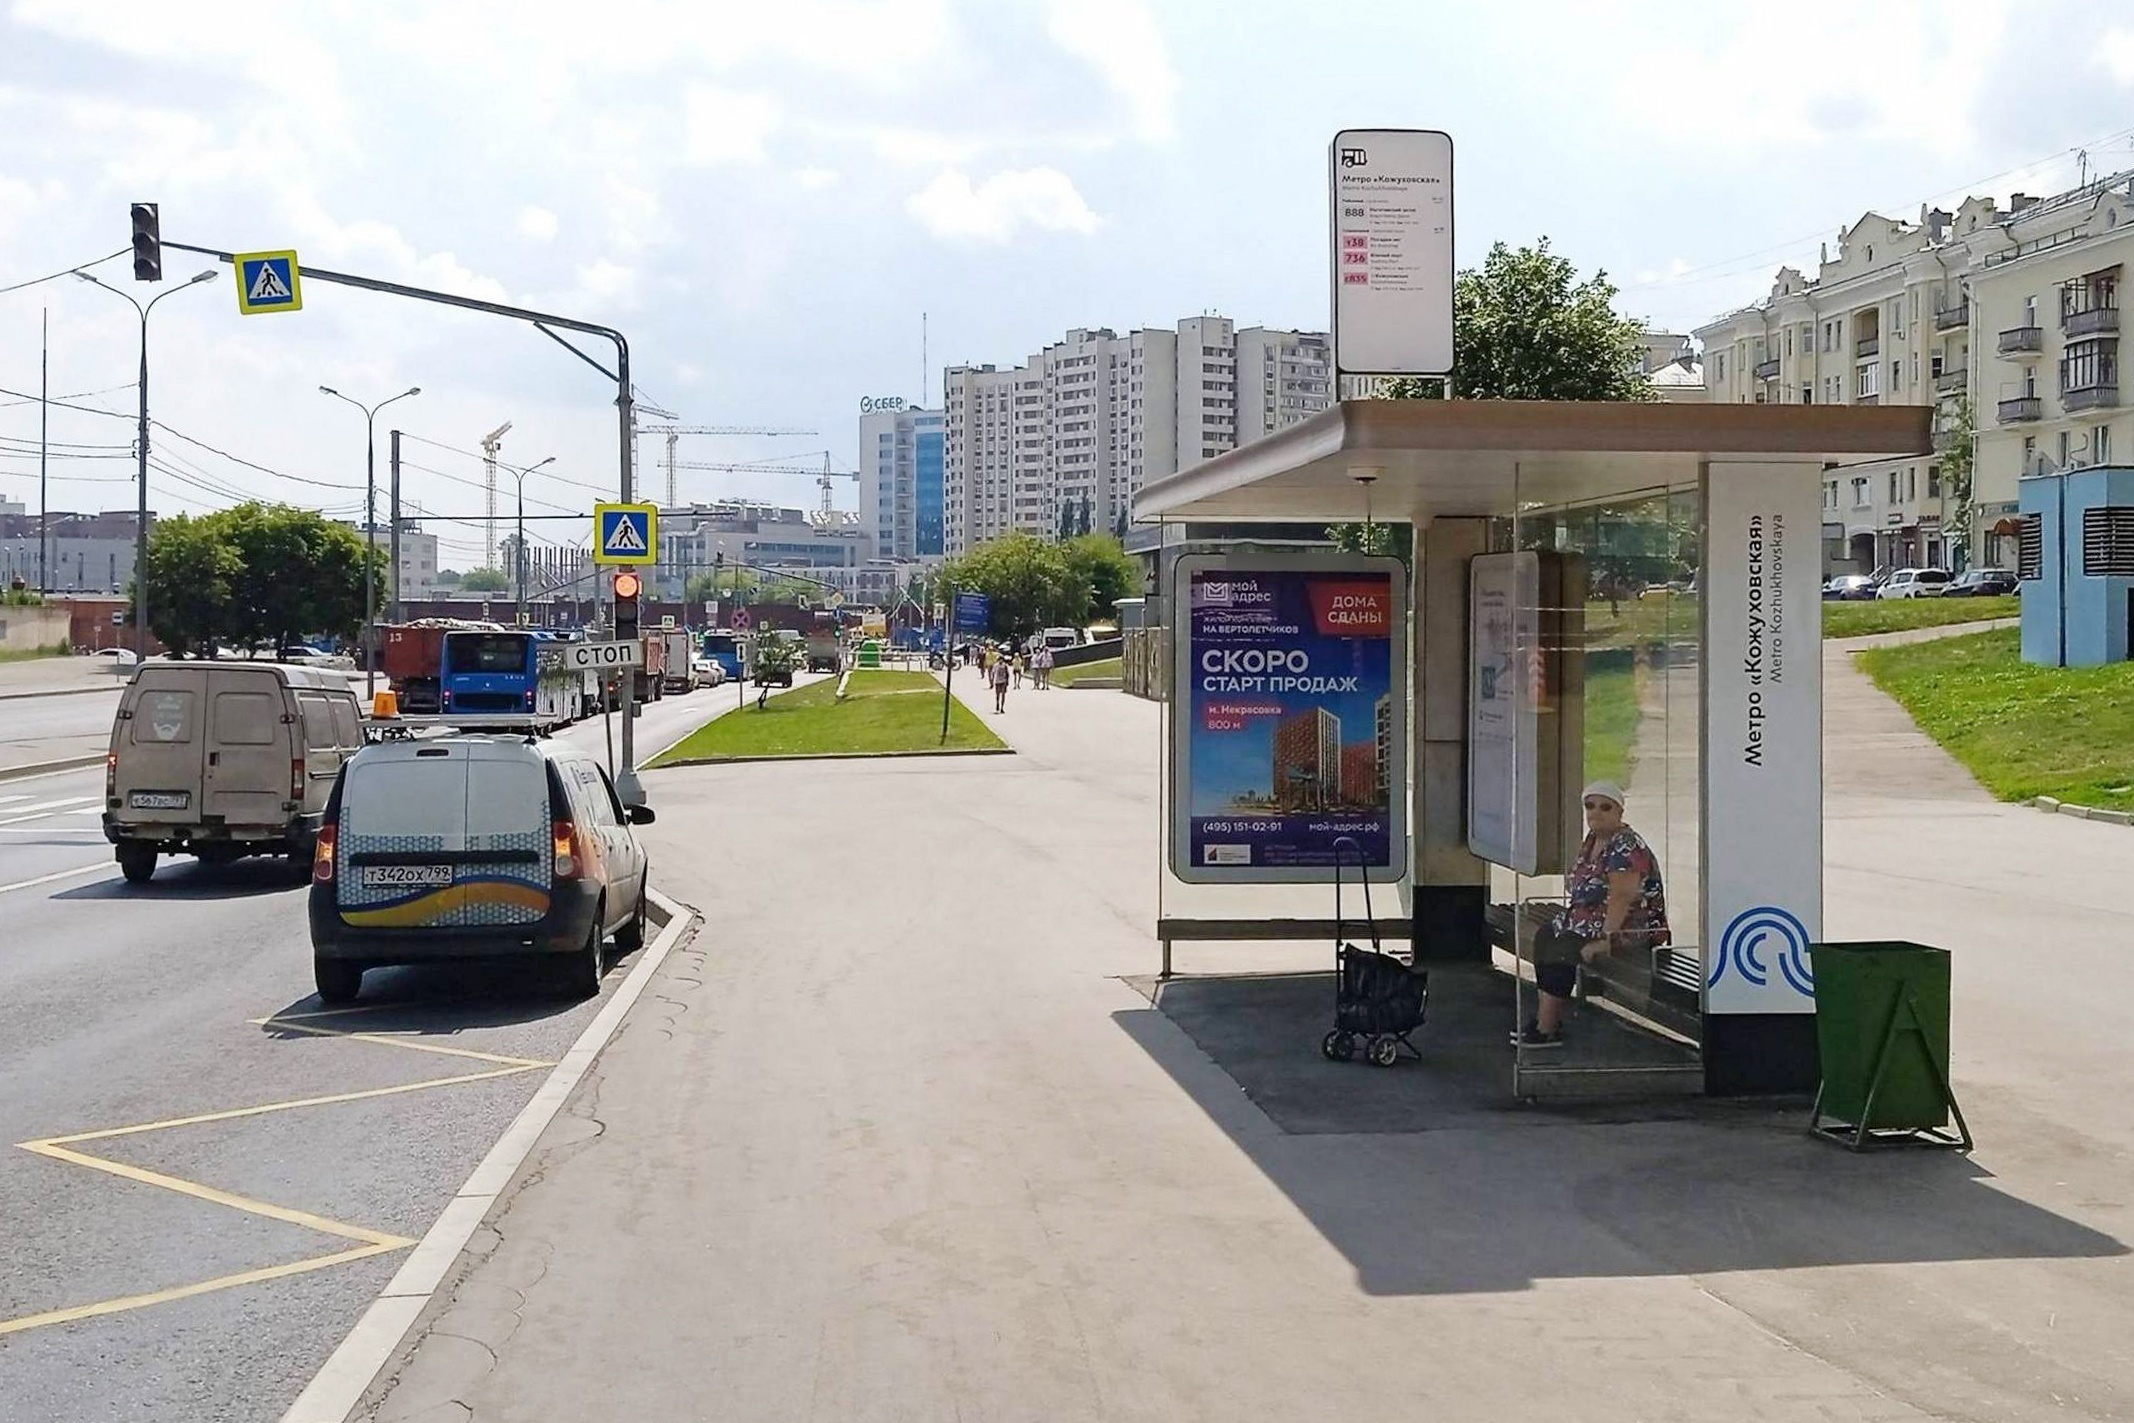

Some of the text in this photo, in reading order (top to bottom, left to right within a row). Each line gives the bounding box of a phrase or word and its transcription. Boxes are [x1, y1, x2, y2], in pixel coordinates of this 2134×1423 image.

[1342, 175, 1371, 184] Метро
[1345, 208, 1364, 218] 888
[1346, 254, 1365, 263] 736
[874, 396, 903, 410] СБЕР
[1231, 580, 1258, 591] мой
[1231, 592, 1271, 604] адрес
[1332, 596, 1377, 609] ДОМА
[1770, 514, 1784, 683] Metro Kozhukhovskaya
[1327, 611, 1382, 625] СДАНЫ
[1203, 625, 1299, 634] НА ВЕРТОЛЕТЧИКОВ
[1744, 515, 1766, 766] Метро «Кожуховская»
[575, 645, 631, 665] СТОП
[1202, 649, 1309, 673] СКОРО
[1203, 676, 1358, 694] СТАРТ ПРОДАЖ
[1221, 705, 1282, 716] Некрасовка
[1202, 821, 1282, 834] (495) 151-02-91
[1309, 820, 1380, 835] мой-адрес.рф
